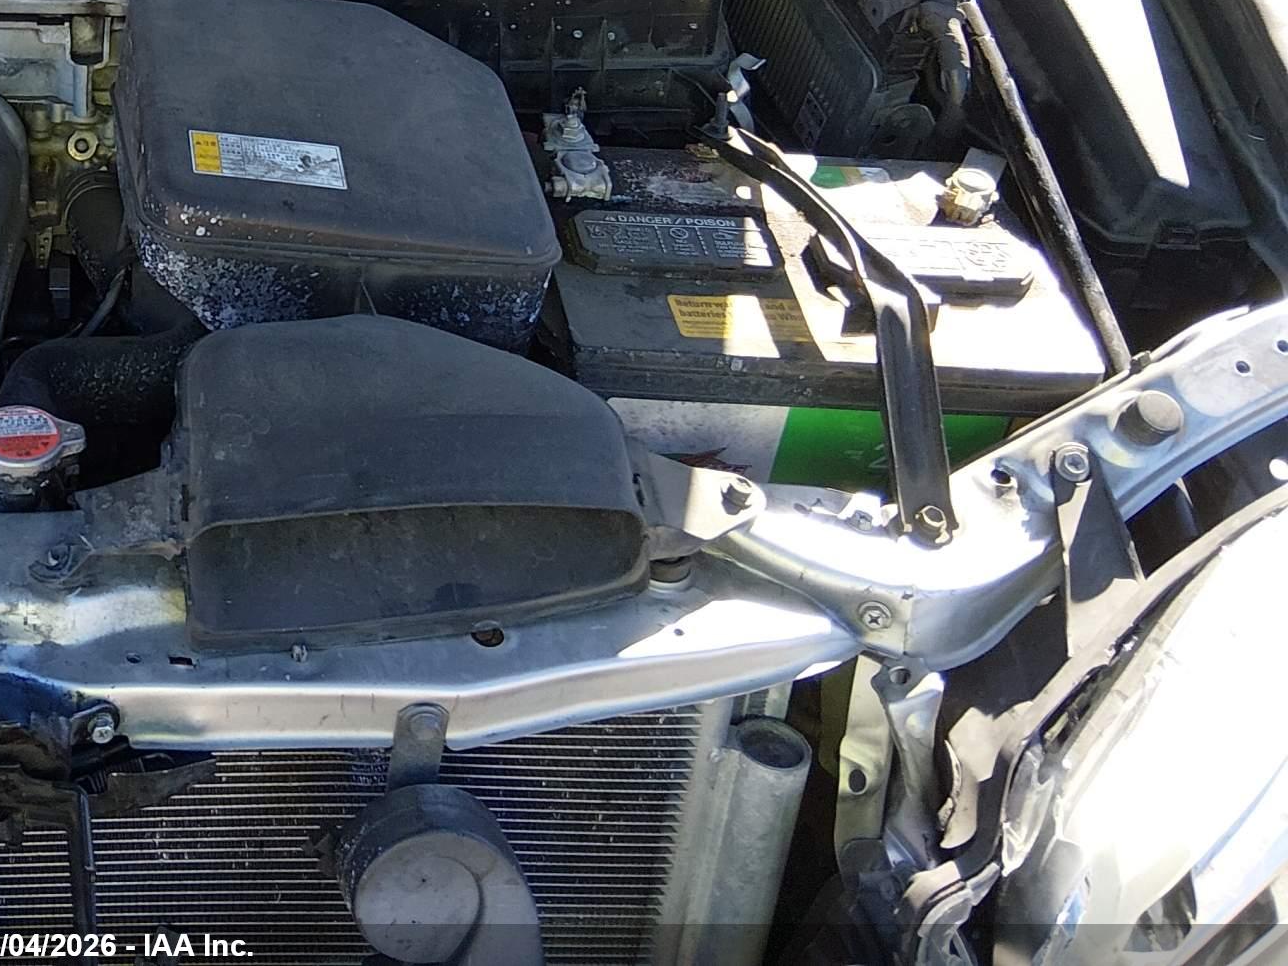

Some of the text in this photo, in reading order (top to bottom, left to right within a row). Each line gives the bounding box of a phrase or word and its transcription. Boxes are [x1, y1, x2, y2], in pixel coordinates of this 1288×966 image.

[618, 214, 673, 225] DANGER
[687, 217, 737, 227] POISON
[678, 308, 727, 319] batteries
